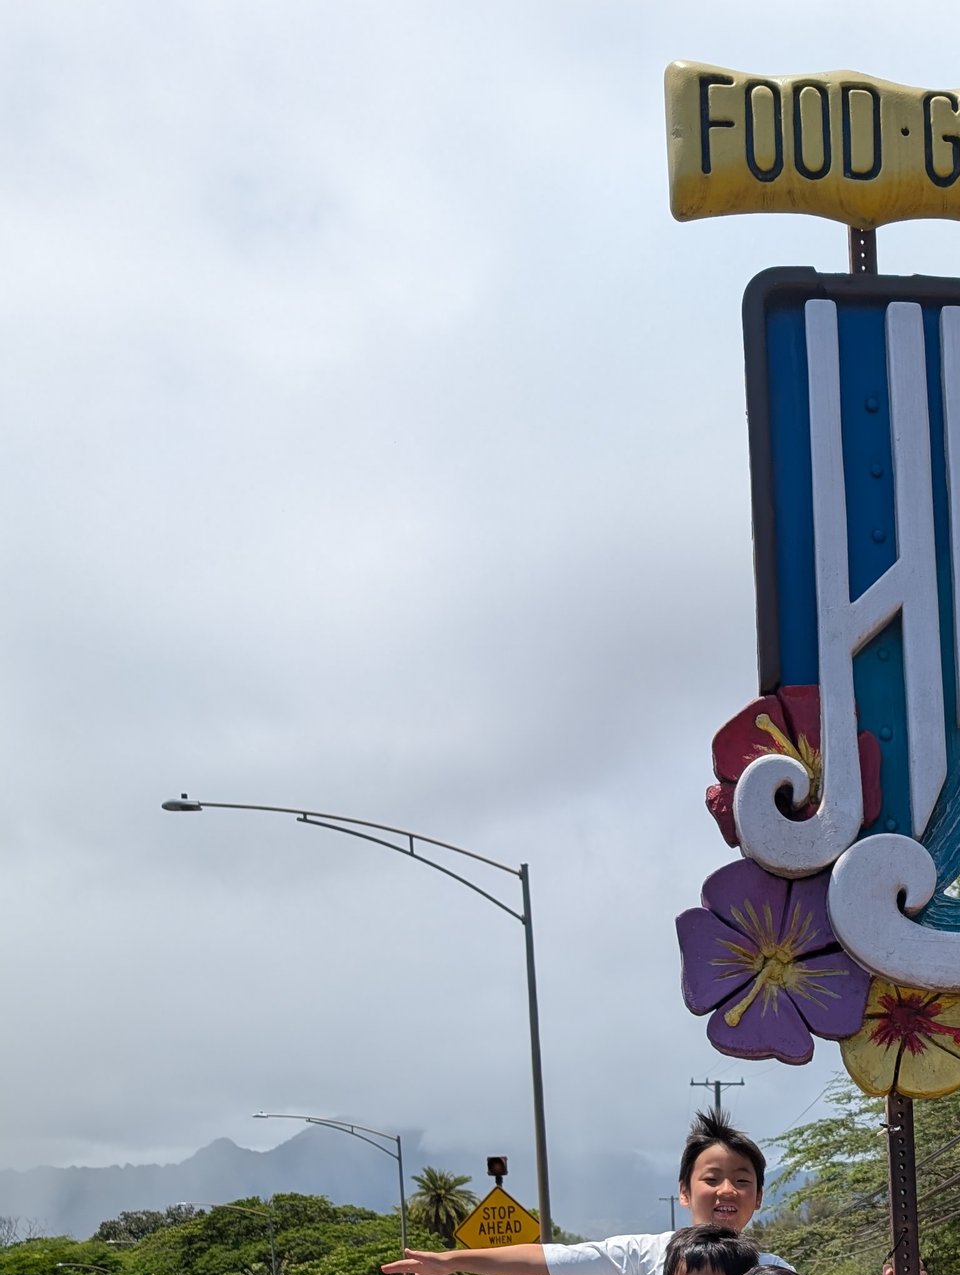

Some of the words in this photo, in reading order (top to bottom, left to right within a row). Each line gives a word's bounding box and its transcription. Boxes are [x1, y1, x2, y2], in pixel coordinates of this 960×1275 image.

[699, 75, 883, 182] FOOD
[483, 1206, 515, 1220] STOP
[478, 1220, 522, 1235] AHEAD
[488, 1236, 512, 1245] WHEN
